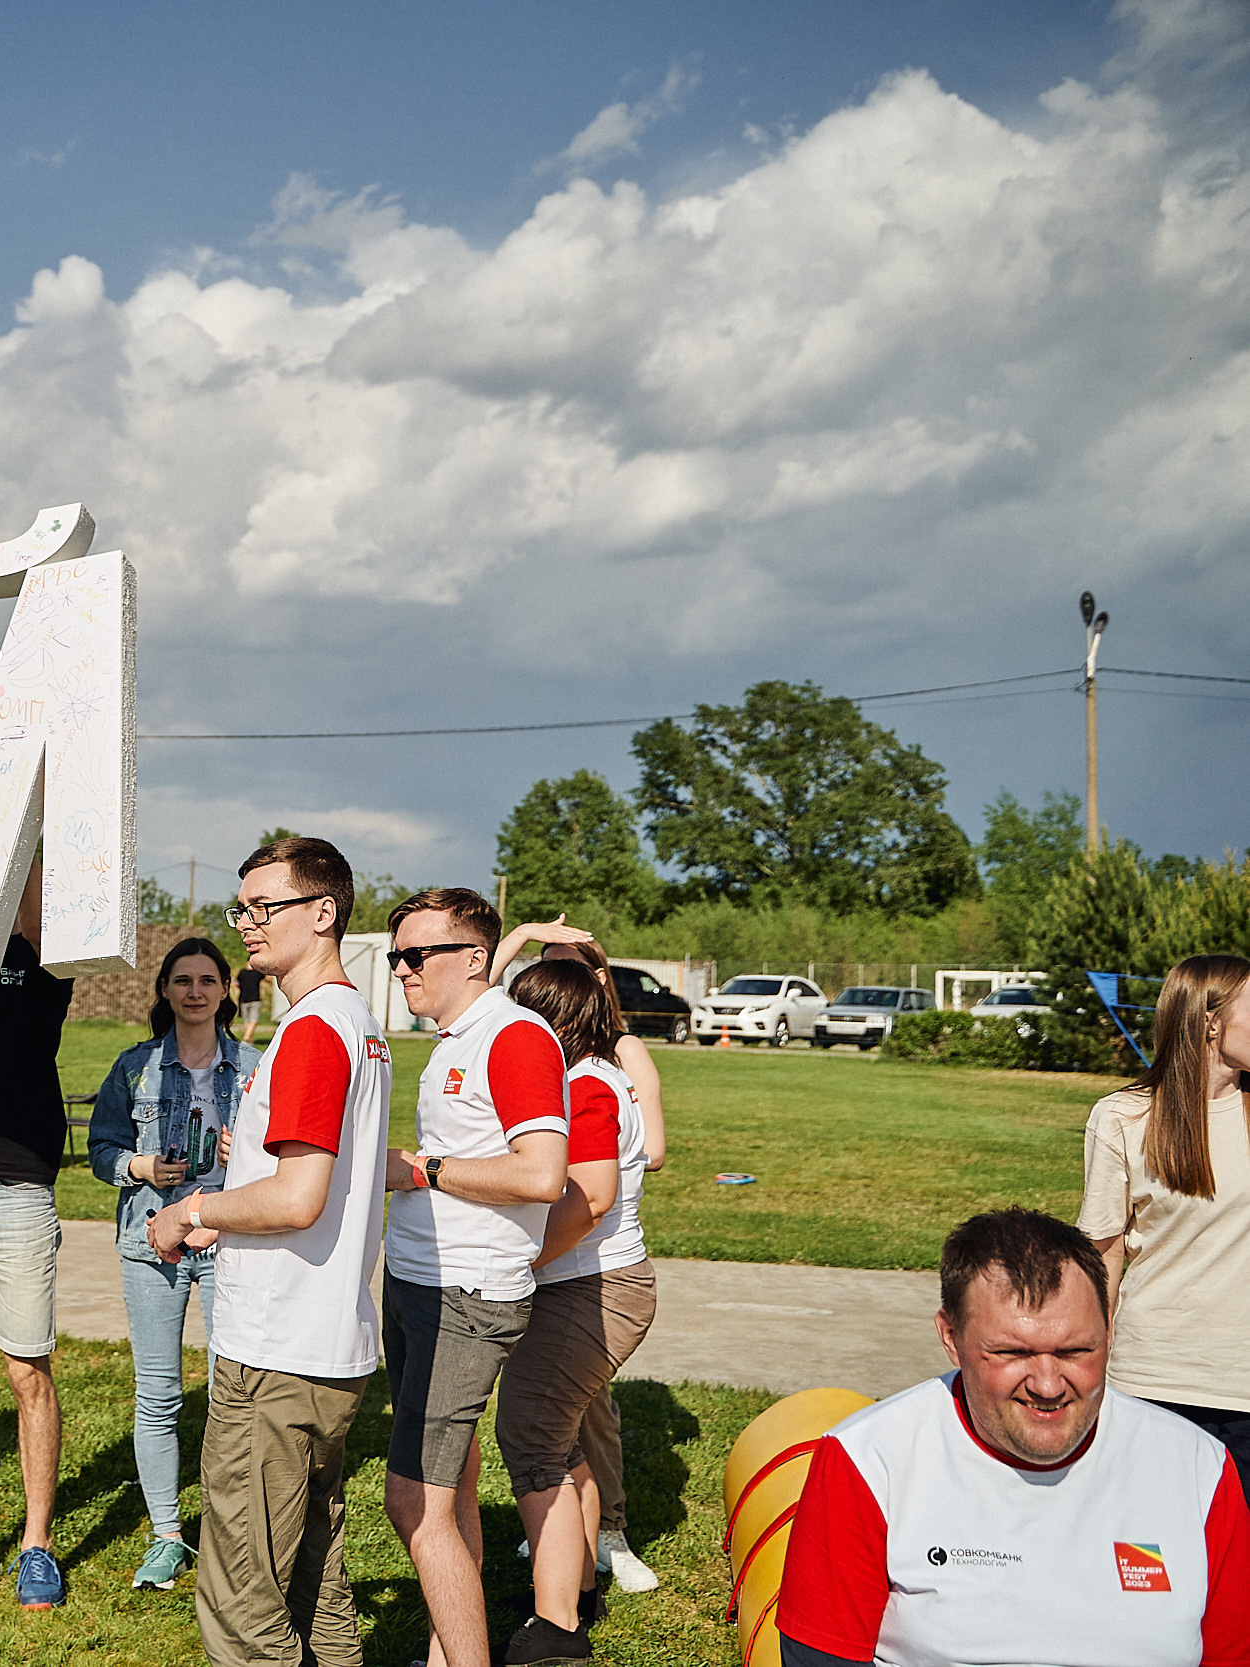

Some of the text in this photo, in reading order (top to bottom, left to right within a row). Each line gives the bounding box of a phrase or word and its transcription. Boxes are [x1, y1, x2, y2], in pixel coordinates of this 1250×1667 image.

[950, 1548, 1023, 1563] СОВКОМБАНК
[951, 1558, 1007, 1568] ТЕХНОЛОГИИ
[1120, 1566, 1163, 1574] SUMMER
